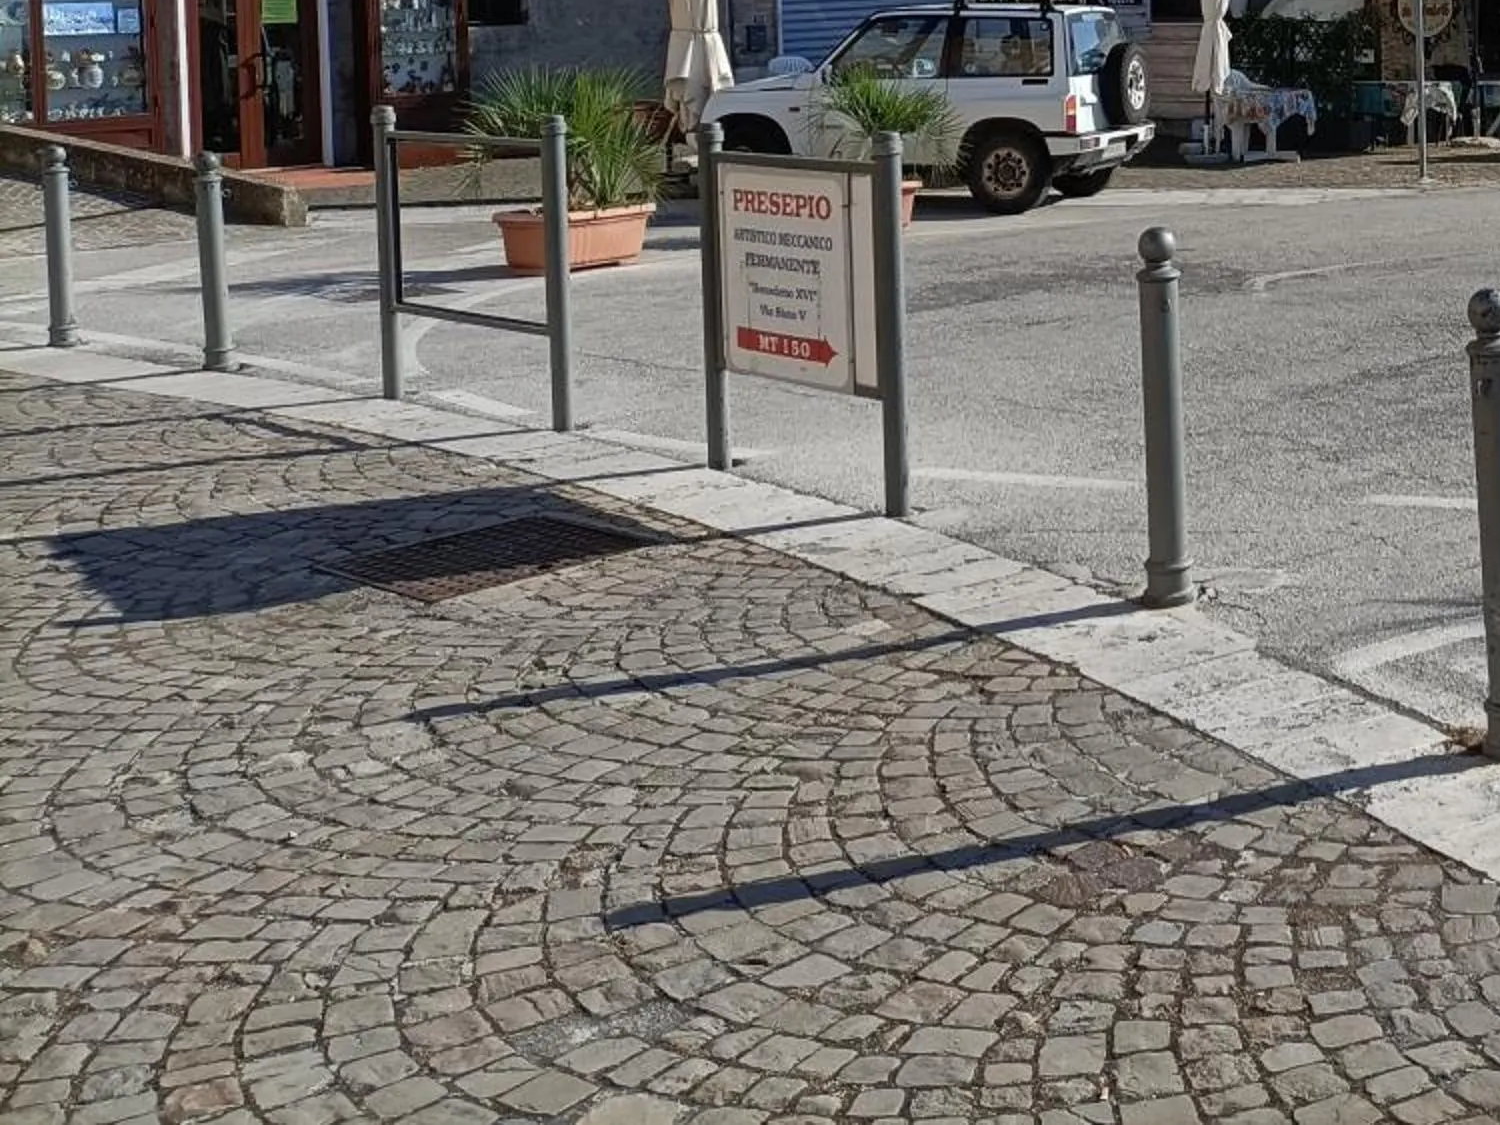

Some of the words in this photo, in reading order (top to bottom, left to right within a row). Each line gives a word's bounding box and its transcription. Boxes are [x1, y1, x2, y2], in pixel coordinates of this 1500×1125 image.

[732, 188, 832, 220] PRESEPIO
[733, 227, 777, 247] ARTISTICO
[778, 232, 833, 252] MECCANICO
[745, 251, 821, 275] PERMANENTE
